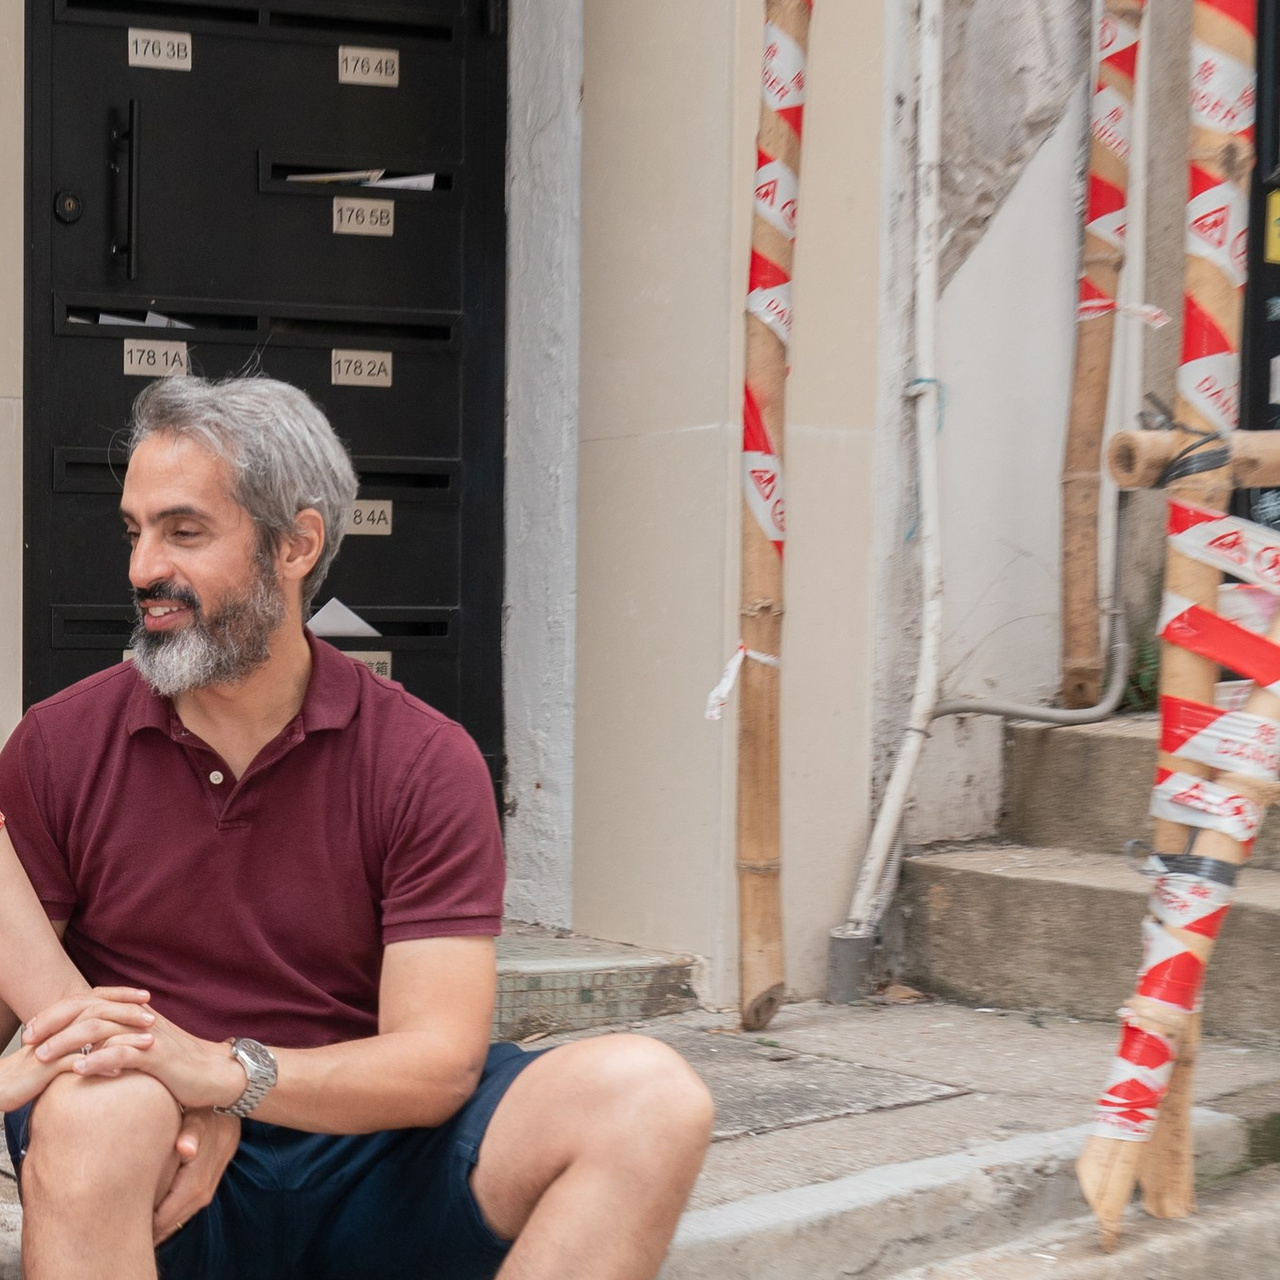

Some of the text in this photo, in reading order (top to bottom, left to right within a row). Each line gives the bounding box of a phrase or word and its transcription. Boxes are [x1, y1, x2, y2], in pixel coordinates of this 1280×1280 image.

[132, 37, 188, 60] 176 3B
[341, 56, 396, 77] 176 4B
[336, 206, 390, 227] 176 5B
[127, 348, 184, 368] 178 1A
[334, 358, 389, 378] 178 2A
[365, 508, 389, 526] 4A
